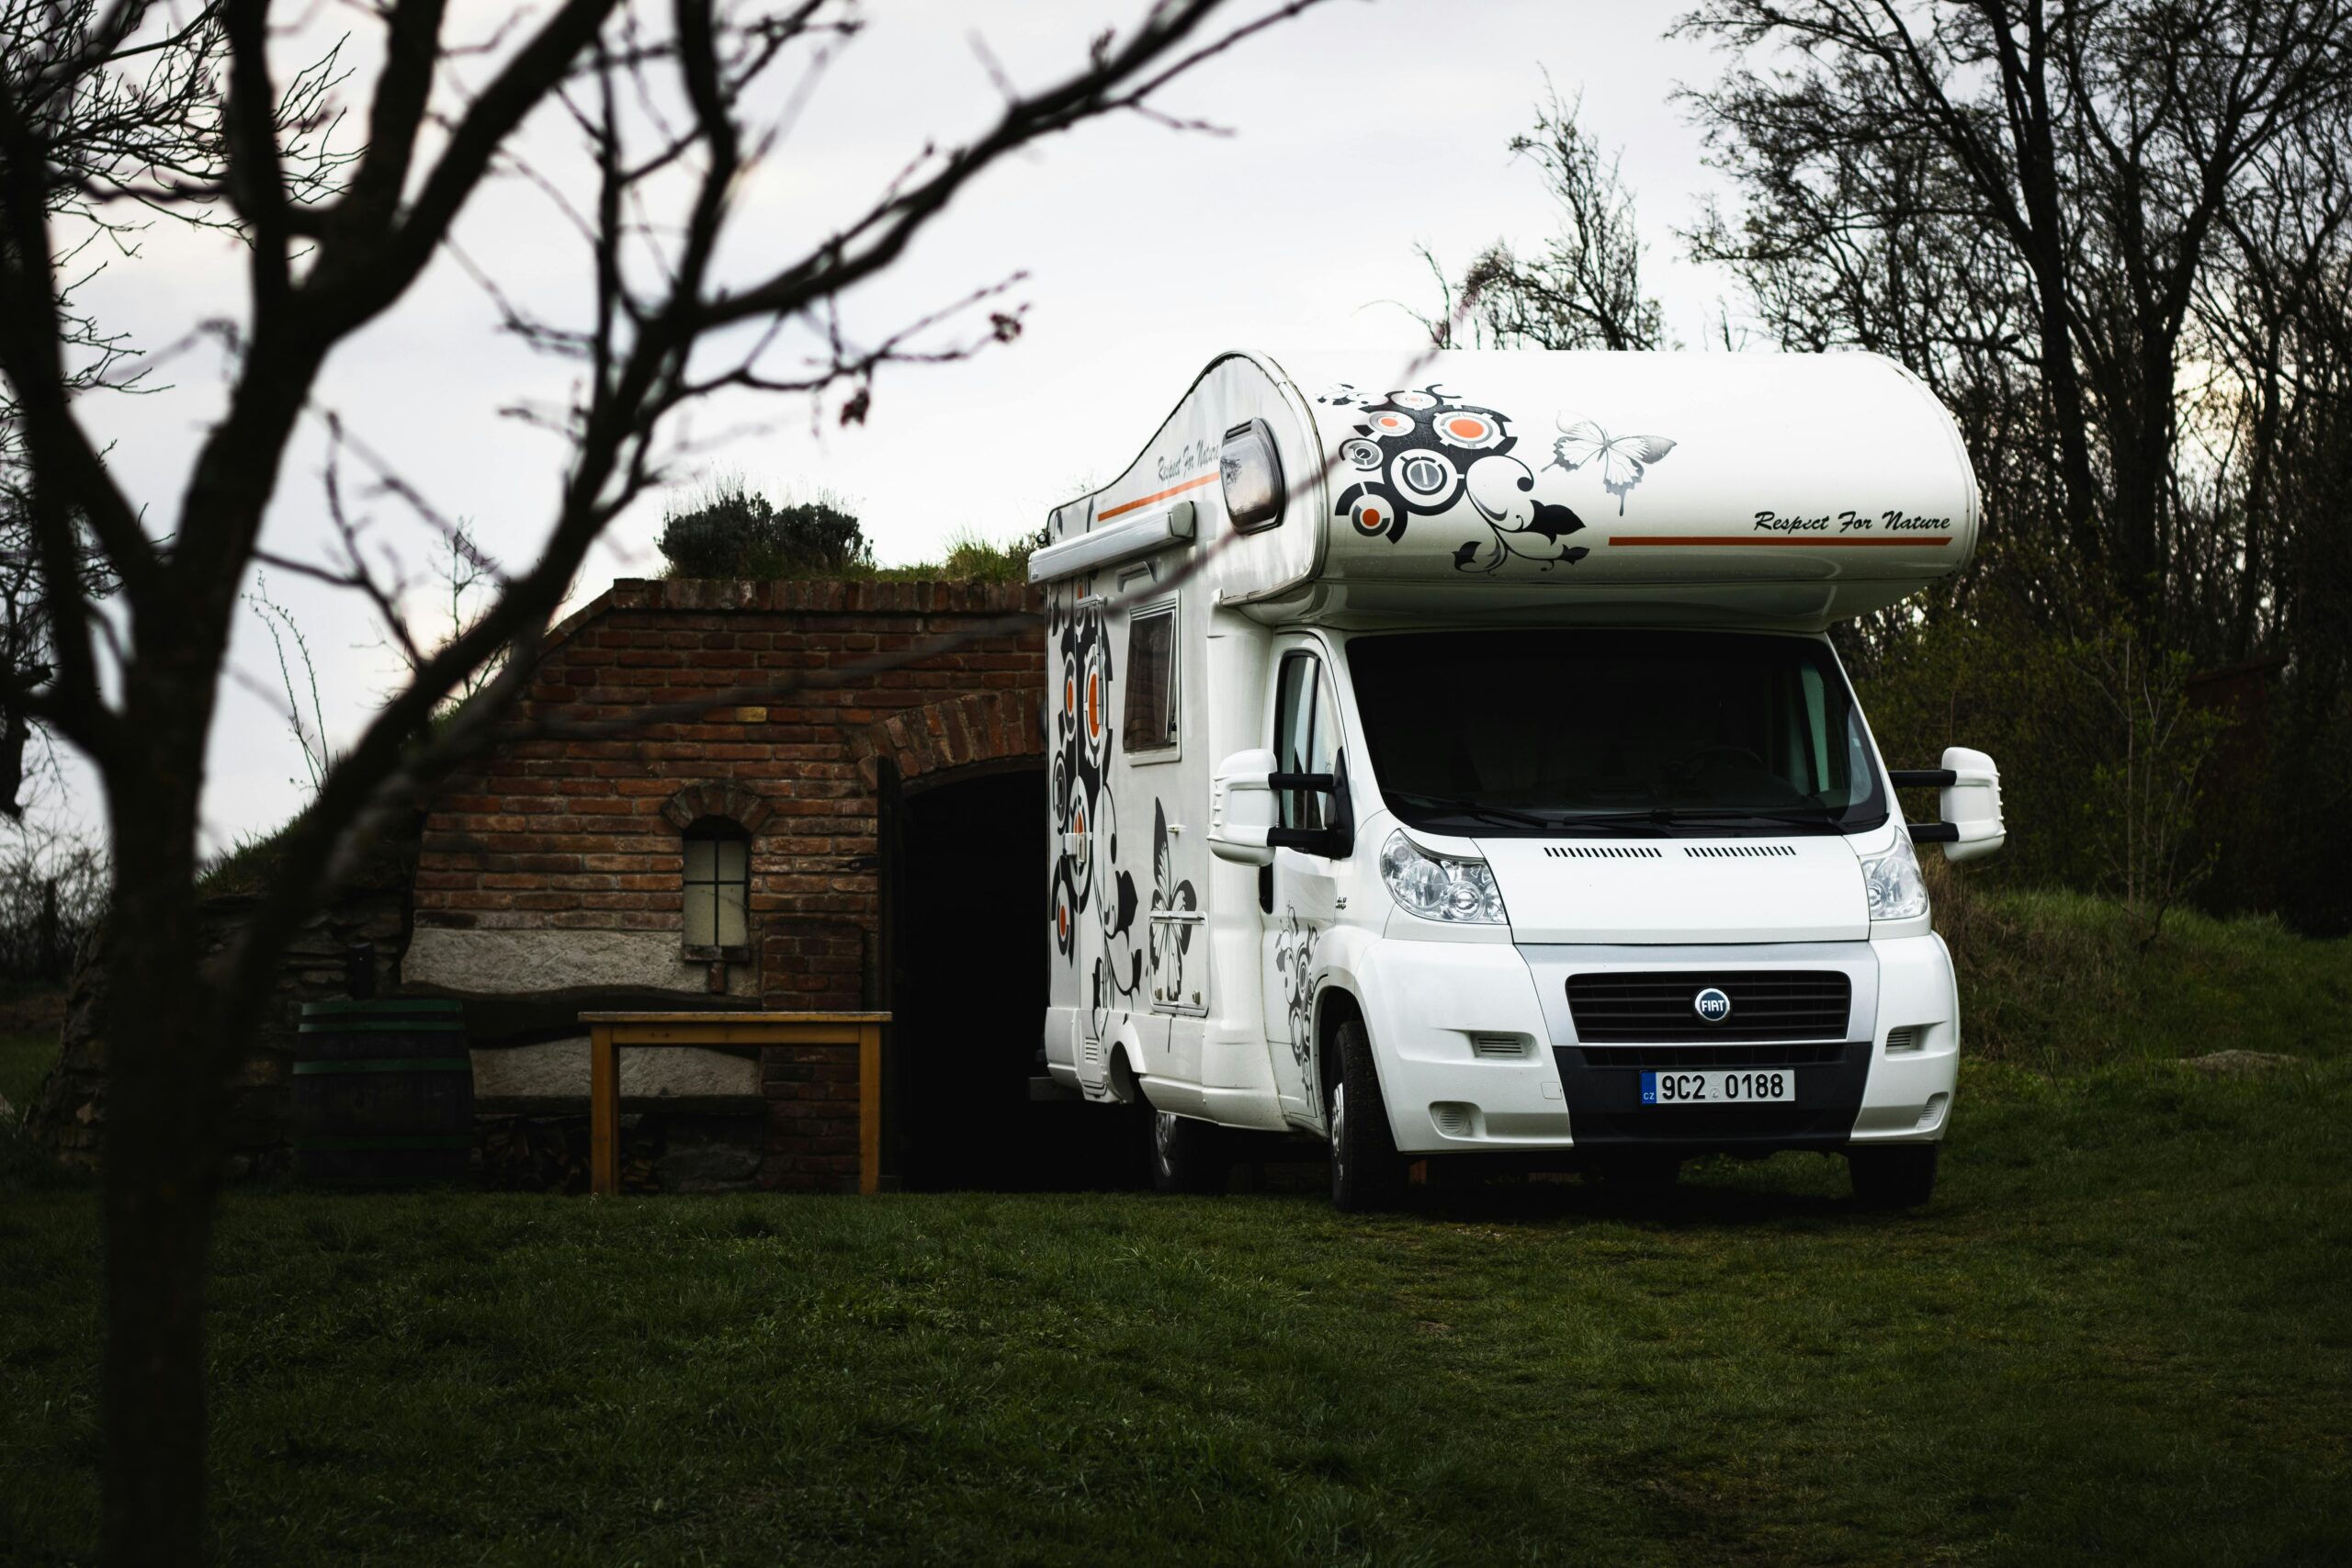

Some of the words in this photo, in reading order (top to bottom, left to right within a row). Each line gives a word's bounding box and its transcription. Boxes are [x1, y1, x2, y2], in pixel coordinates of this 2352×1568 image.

[1754, 511, 1829, 535] Respect
[1838, 511, 1872, 534] For
[1882, 510, 1951, 531] Nature
[1701, 999, 1724, 1011] FIAT
[1643, 1092, 1655, 1100] CZ
[1661, 1075, 1706, 1100] 9C2
[1724, 1073, 1784, 1099] 0188
